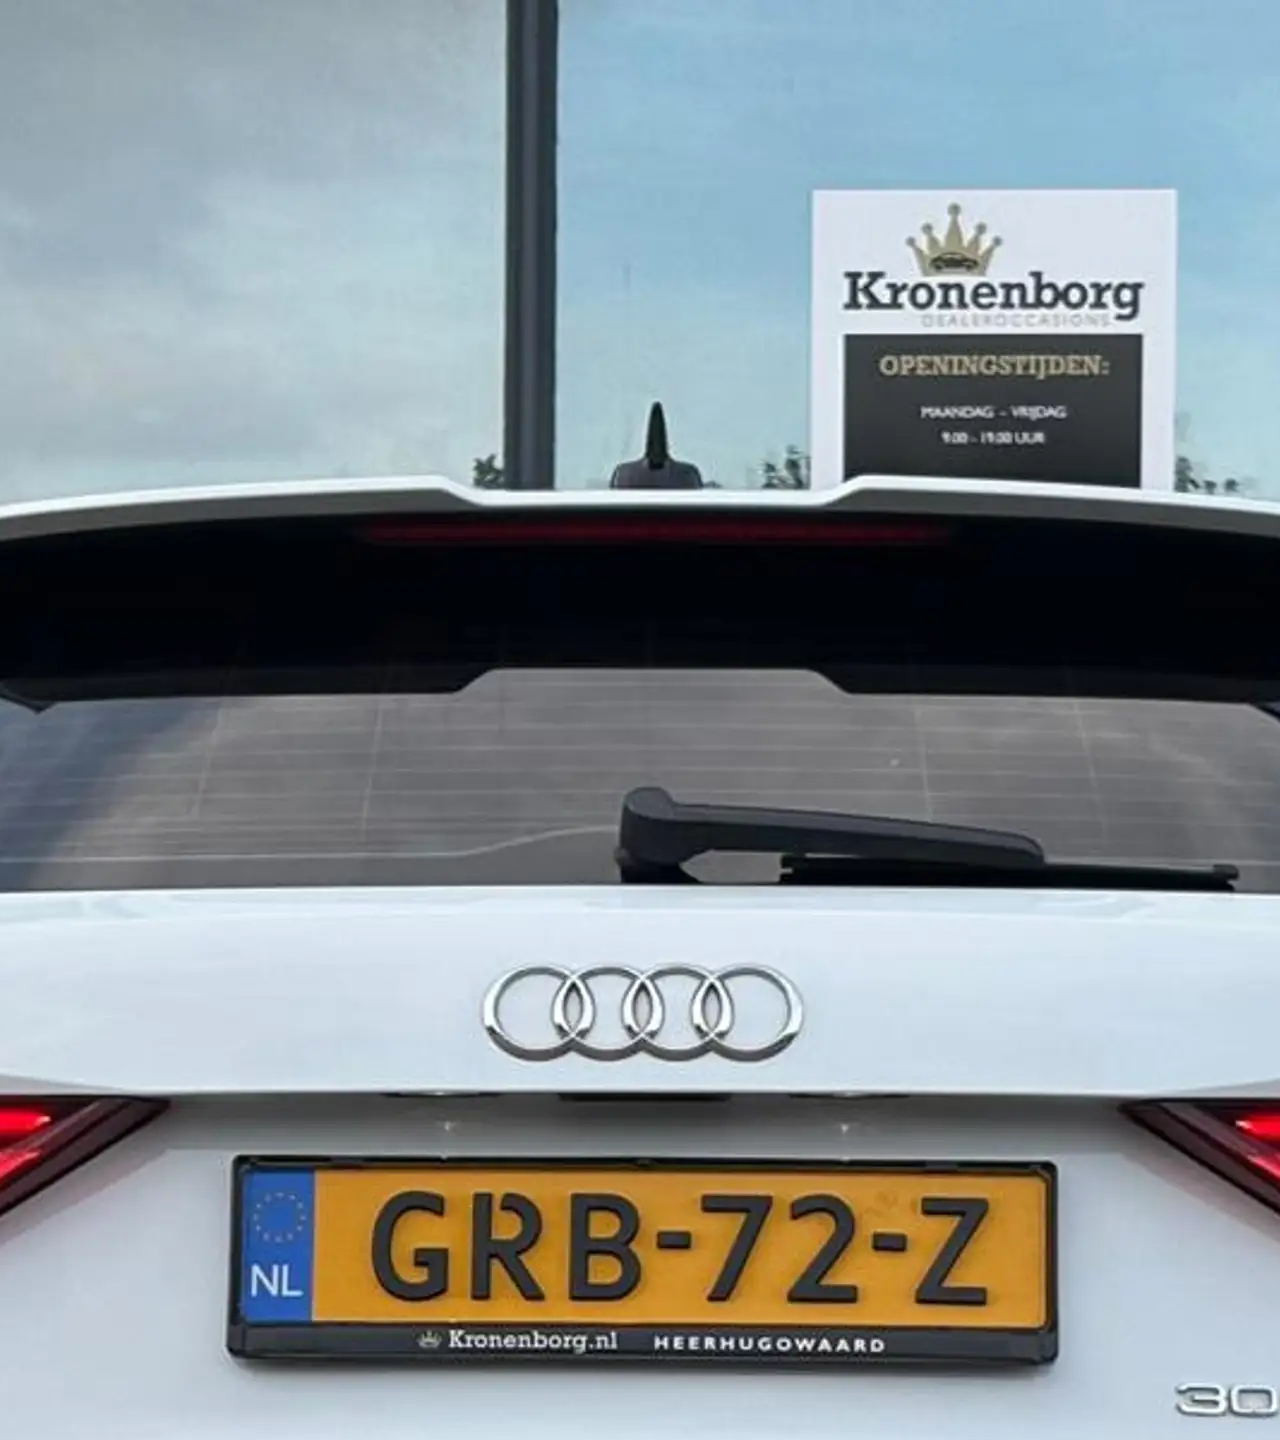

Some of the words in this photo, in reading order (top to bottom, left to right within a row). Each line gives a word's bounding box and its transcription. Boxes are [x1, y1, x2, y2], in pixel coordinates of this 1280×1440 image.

[843, 271, 1144, 320] Kronenborg
[879, 355, 1110, 379] OPENINGSTIJDEN:
[920, 404, 995, 420] MAANDAG
[1011, 404, 1068, 421] VRIJDAG
[371, 1190, 988, 1306] GRB-72-Z
[250, 1263, 304, 1297] NL
[449, 1330, 619, 1354] Kronenborg.nl
[653, 1335, 886, 1353] HEERHUGOWAARD
[1175, 1381, 1280, 1418] 30
